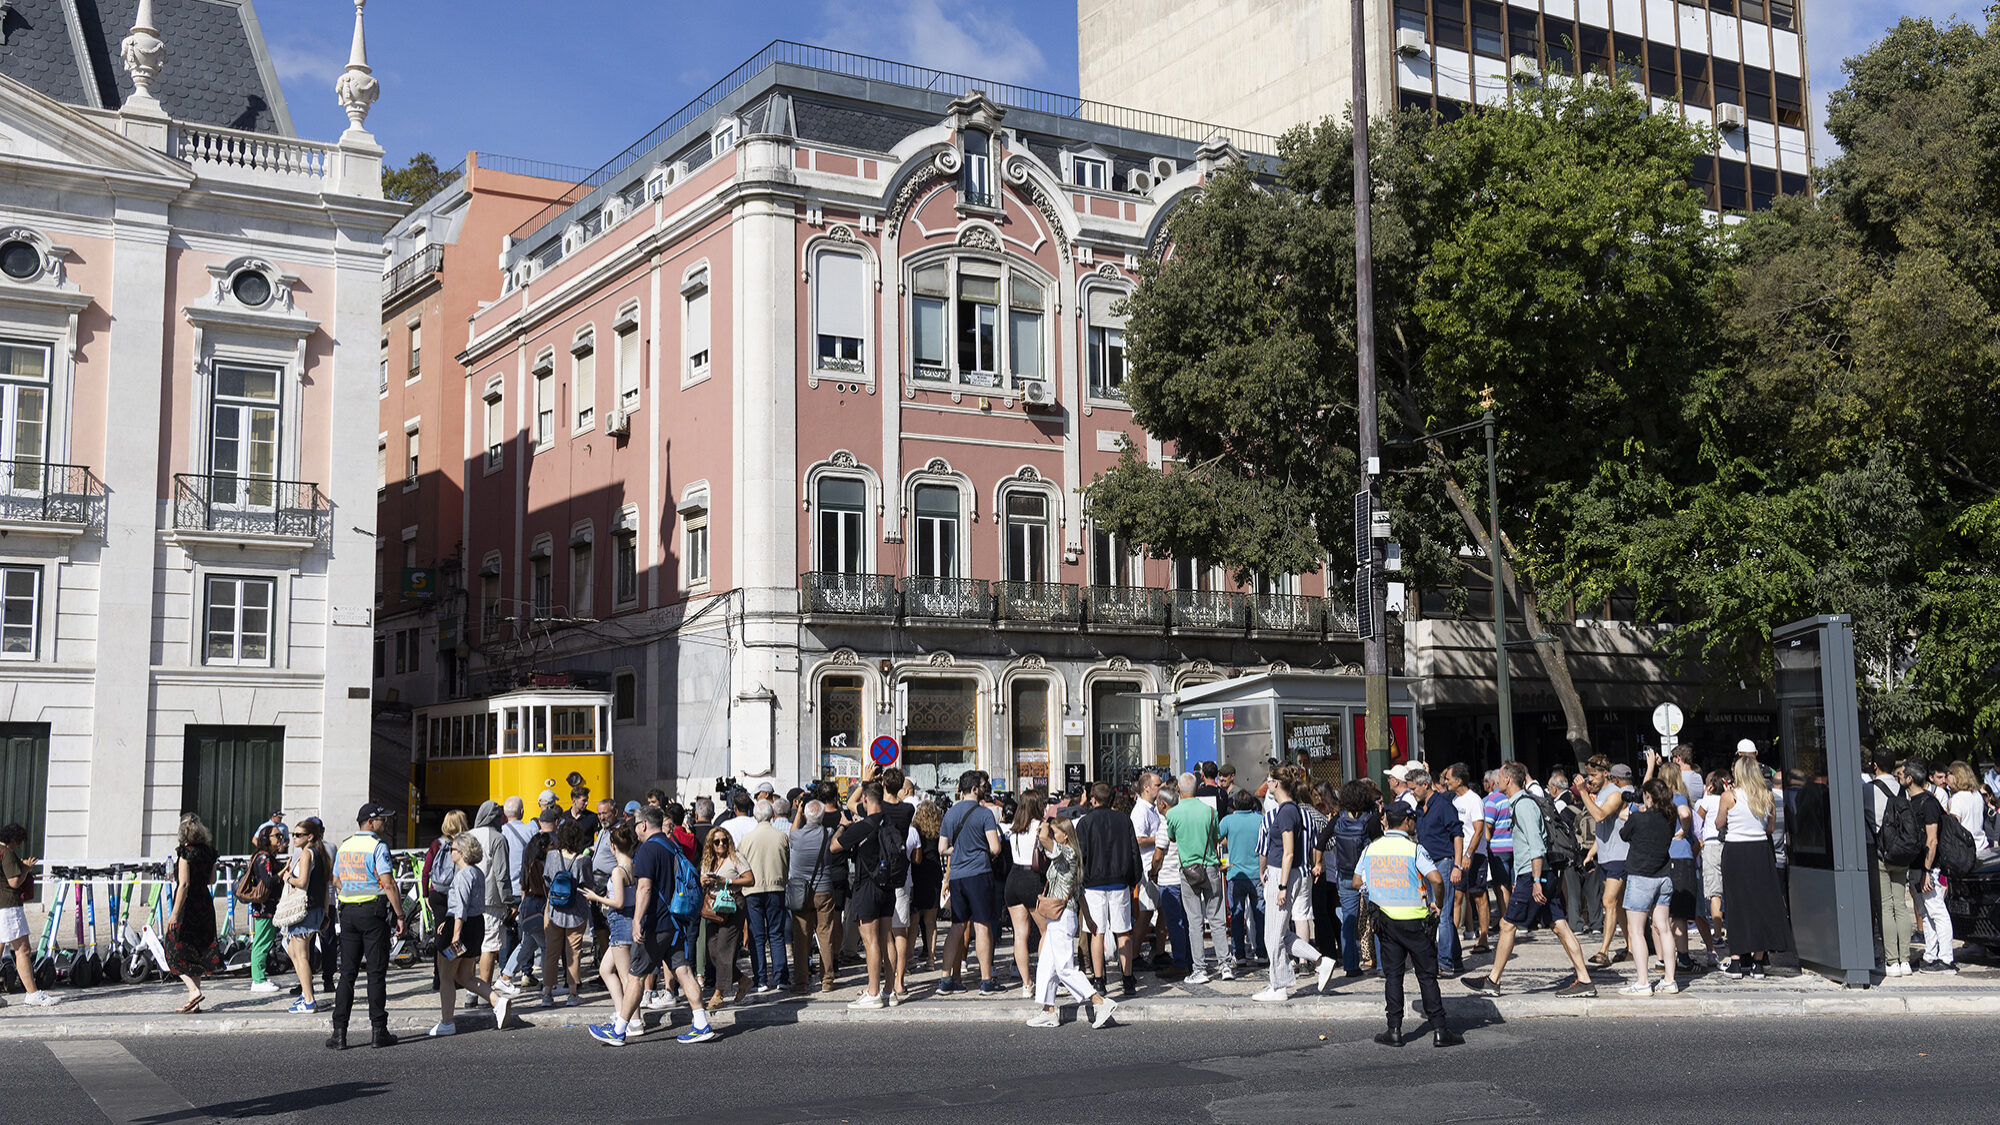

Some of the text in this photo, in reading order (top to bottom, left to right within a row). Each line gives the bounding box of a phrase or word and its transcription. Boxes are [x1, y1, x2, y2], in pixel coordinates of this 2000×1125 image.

[1293, 722, 1330, 737] SER PORTUGUÊS
[1310, 745, 1332, 757] SENTE-SE
[1371, 876, 1408, 888] TRÂNSITO
